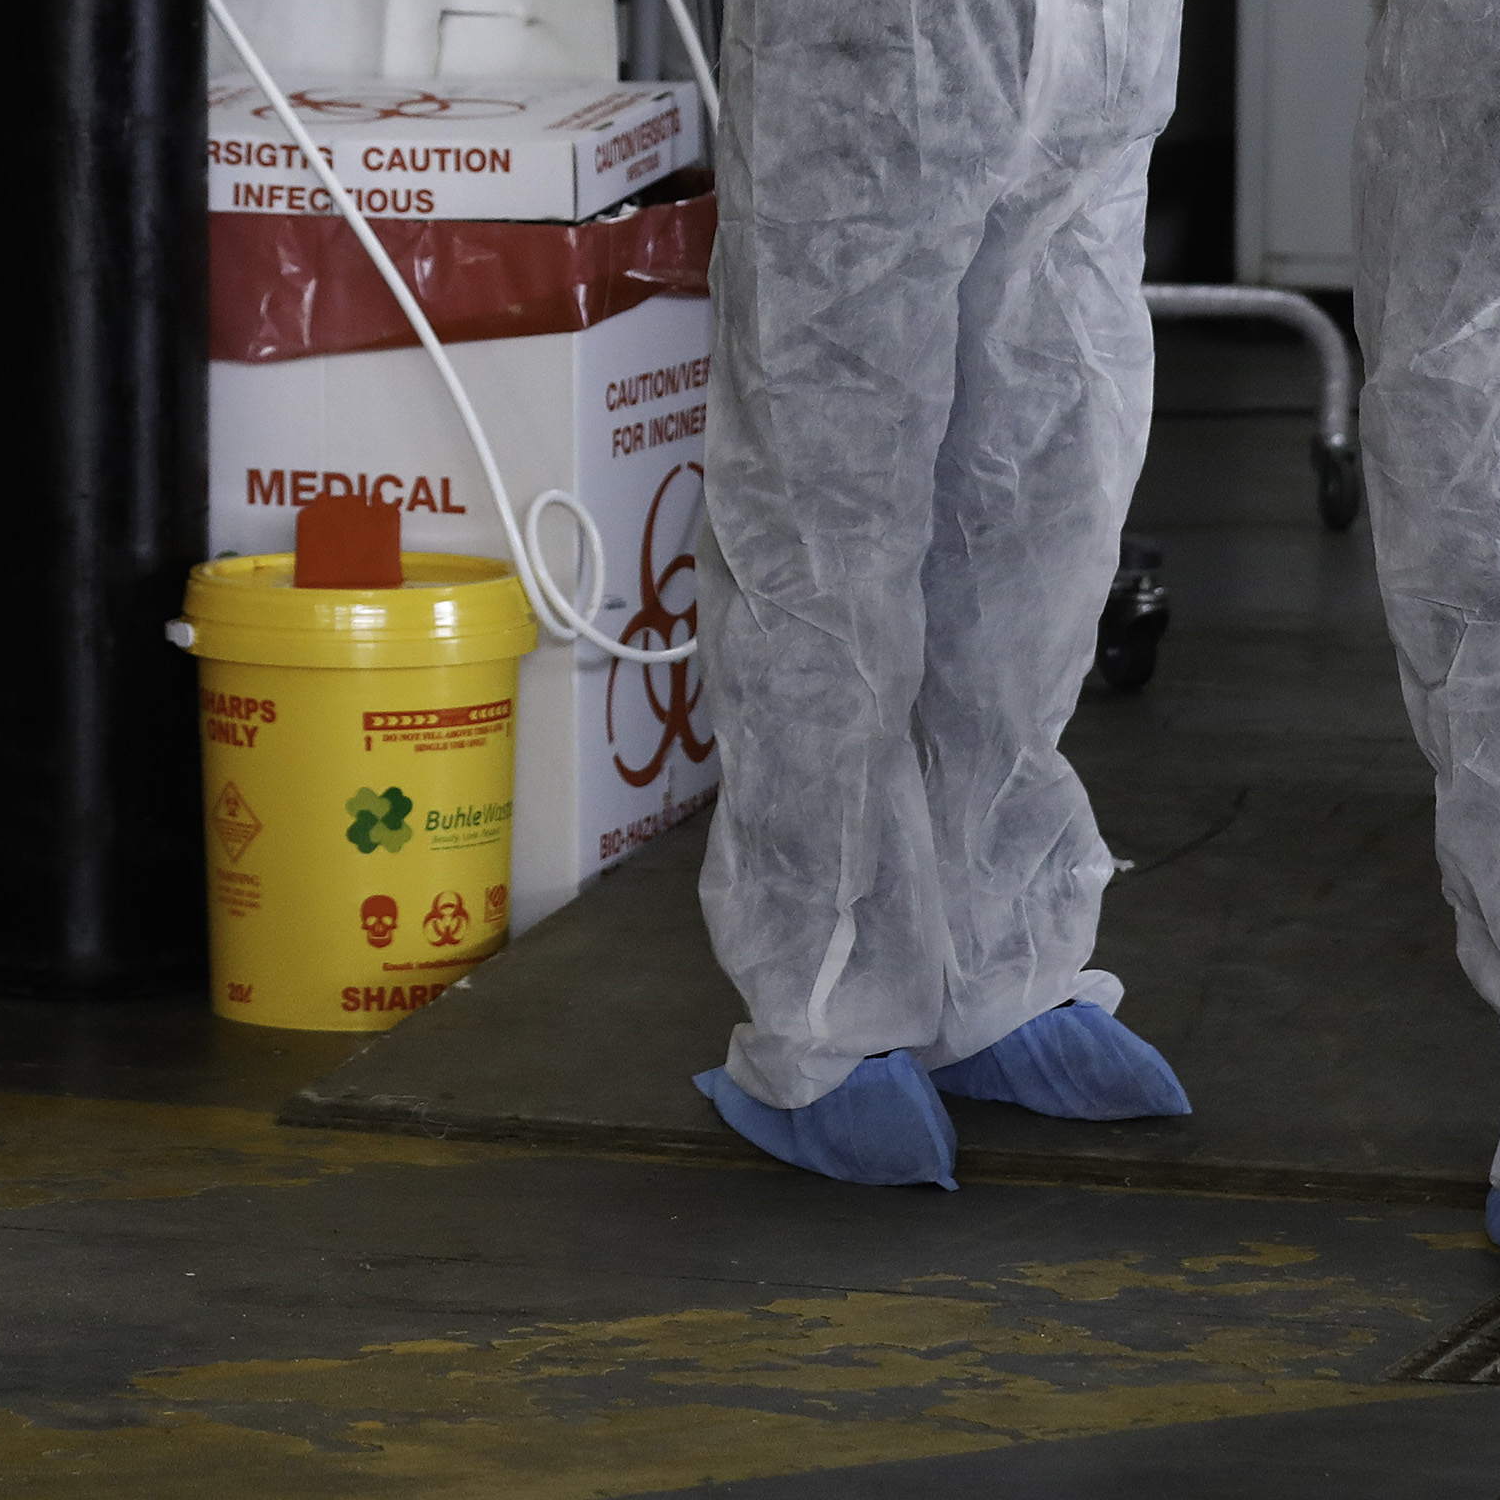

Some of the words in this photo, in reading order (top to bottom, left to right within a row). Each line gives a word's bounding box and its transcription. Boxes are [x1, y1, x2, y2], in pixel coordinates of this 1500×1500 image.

[362, 147, 511, 173] CAUTION
[233, 182, 435, 213] INFECIOUS
[612, 422, 646, 458] FOR
[246, 468, 466, 514] MEDICAL
[206, 718, 258, 748] ONLY
[400, 730, 421, 741] NOT
[445, 726, 473, 738] ABOVE
[414, 741, 449, 752] SINGLE
